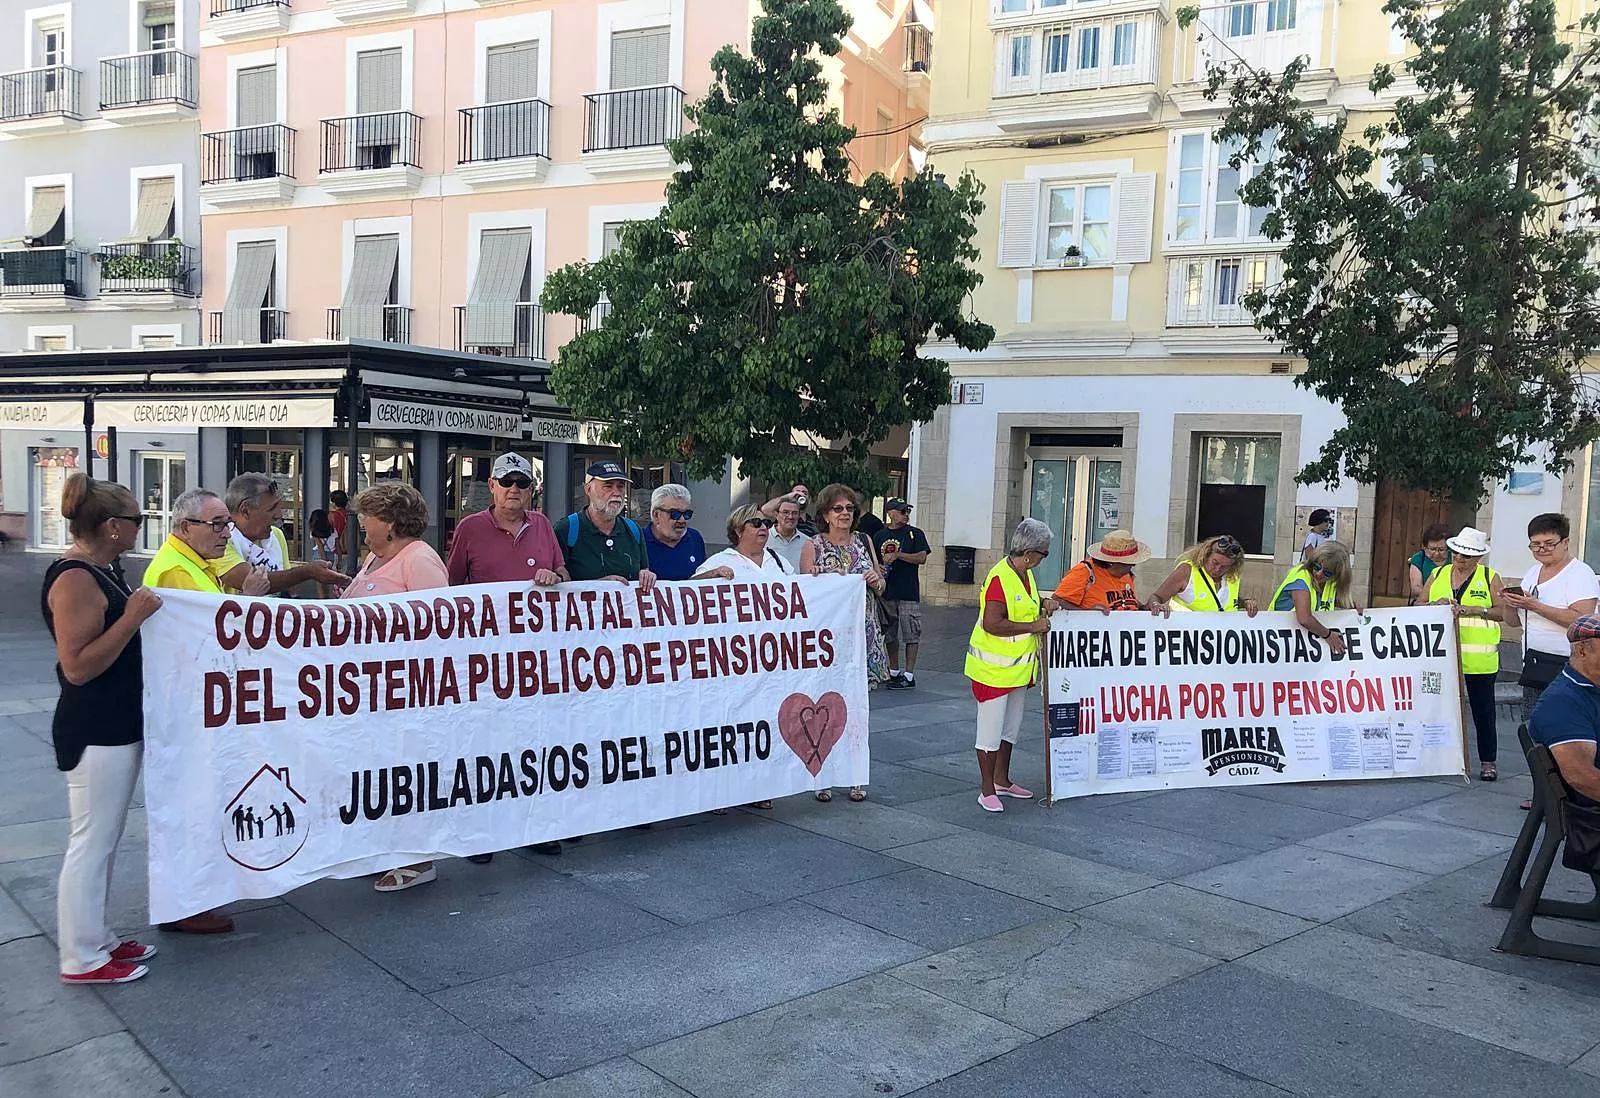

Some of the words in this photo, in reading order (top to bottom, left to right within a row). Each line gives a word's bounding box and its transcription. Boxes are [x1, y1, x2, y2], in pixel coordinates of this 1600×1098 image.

[133, 403, 188, 423] CERVECERIA
[191, 405, 198, 422] Y
[200, 404, 231, 422] COPAS
[233, 405, 266, 422] NUEVA
[269, 405, 288, 422] OLA
[377, 403, 435, 428] CERVECERIA
[438, 410, 443, 427] Y
[446, 411, 475, 430] COPAS
[476, 416, 503, 432] NUEVA
[506, 456, 521, 468] NY
[215, 591, 497, 650] COORDINADORA
[507, 587, 633, 634] ESTATAL
[637, 586, 678, 628] EN
[682, 582, 808, 626] DEFENSA
[1049, 630, 1115, 669] MAREA
[1119, 630, 1147, 667] DE
[1154, 628, 1323, 665] PENSIONISTAS
[1370, 617, 1447, 660] CÁDIZ
[203, 667, 288, 728] DEL
[298, 655, 460, 719] SISTEMA
[467, 645, 618, 703] PUBLICO
[622, 641, 666, 686] DE
[668, 629, 835, 682] PENSIONES
[1100, 684, 1173, 724] LUCHA
[1179, 682, 1227, 720] POR
[1232, 681, 1264, 718] TU
[1272, 670, 1386, 717] PENSIÓN
[1391, 676, 1413, 711] !!!
[1201, 726, 1286, 760] MAREA
[1213, 752, 1276, 768] PENSIONISTA
[339, 742, 590, 826] JUBILADAS/OS
[600, 736, 655, 786] DEL
[664, 719, 773, 776] PUERTO
[1228, 765, 1260, 776] CÁDIZ
